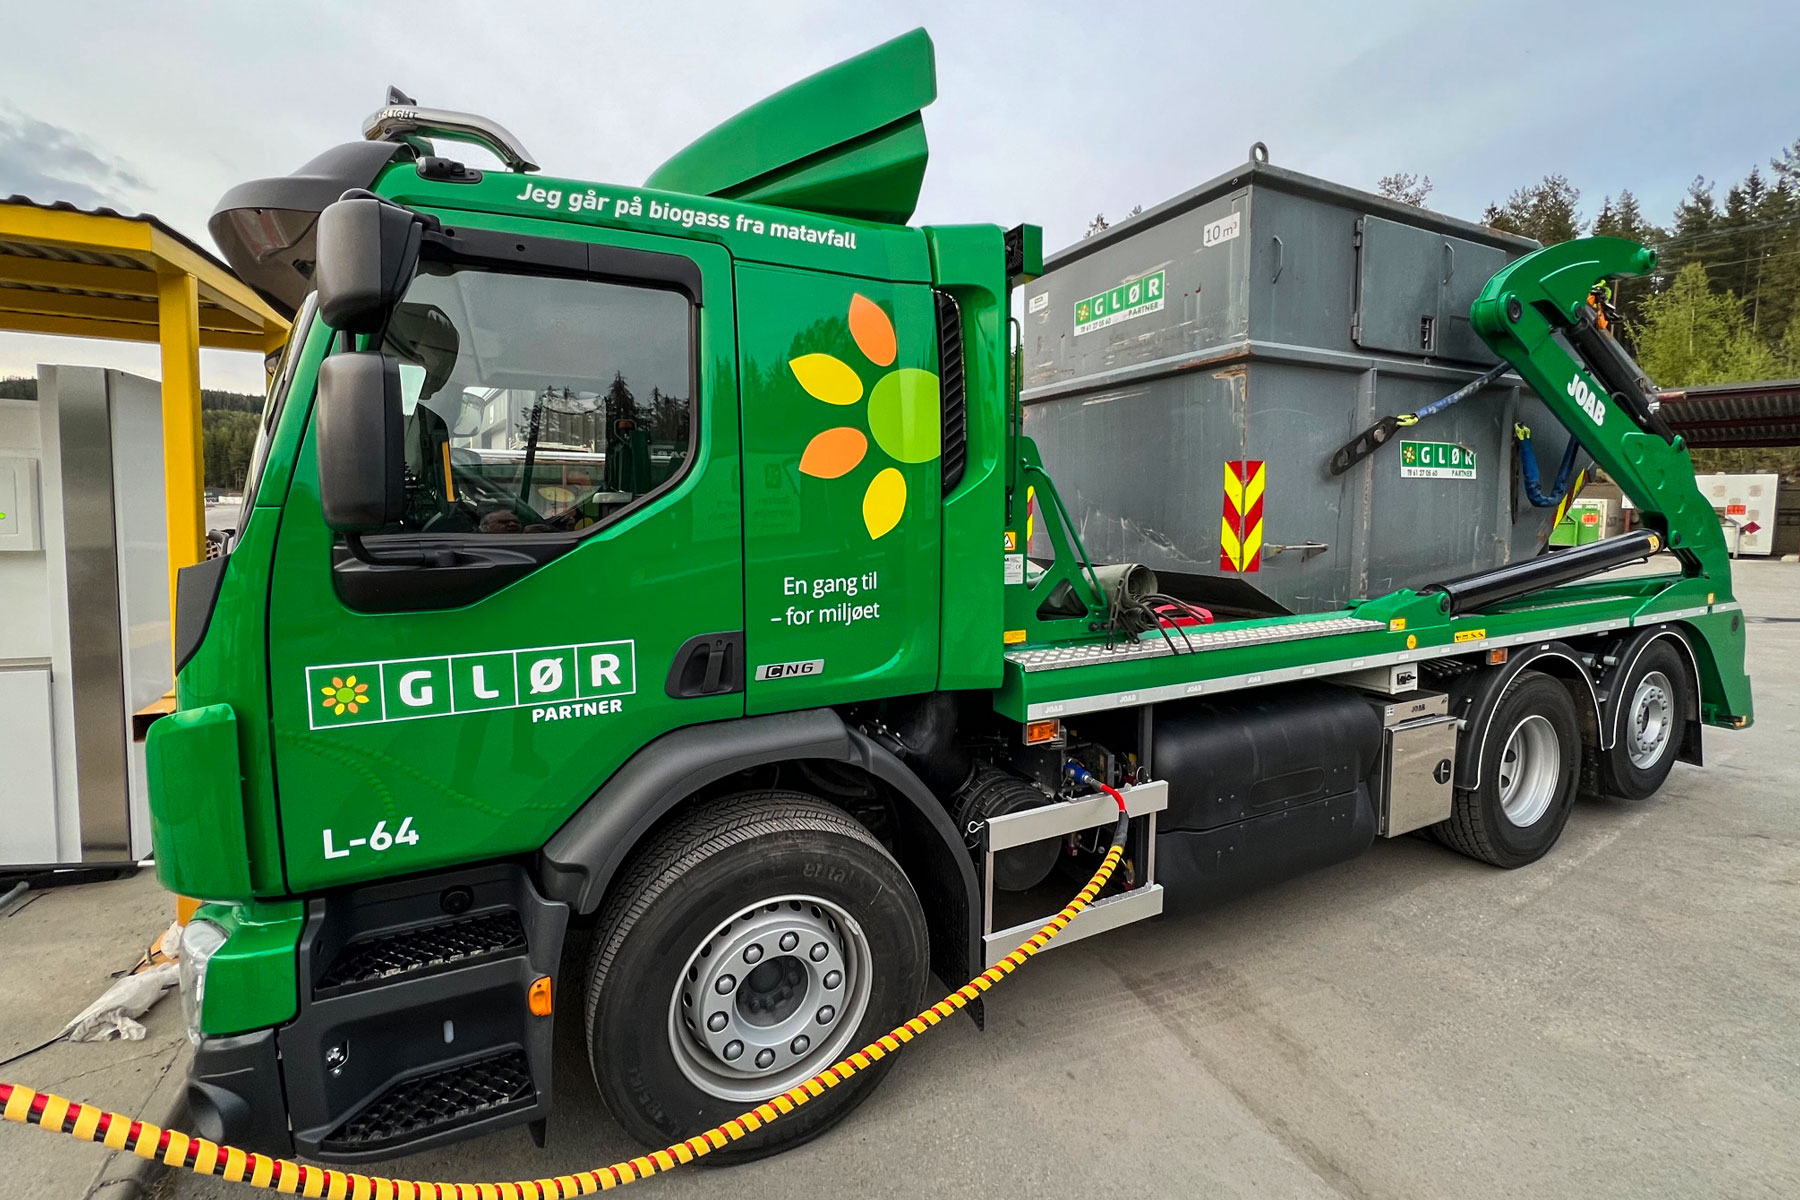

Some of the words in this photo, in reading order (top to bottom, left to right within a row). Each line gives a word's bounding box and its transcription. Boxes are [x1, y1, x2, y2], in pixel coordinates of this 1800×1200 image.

[516, 183, 562, 209] Jeg
[568, 189, 610, 212] går
[614, 196, 643, 218] på
[649, 201, 730, 228] biogass
[735, 214, 764, 235] fra
[769, 223, 857, 250] matavfall
[1206, 225, 1220, 244] 10
[1094, 277, 1160, 316] GLØR
[1128, 301, 1159, 319] PARTNER
[1566, 373, 1606, 427] JOAB
[1421, 446, 1473, 466] GLØR
[1451, 469, 1473, 477] PARTNER
[783, 576, 808, 596] En
[812, 576, 858, 599] gang
[861, 571, 878, 590] til
[786, 606, 815, 626] for
[819, 602, 880, 626] miljøet
[399, 652, 622, 707] GLØR
[765, 662, 814, 679] CNG
[1119, 695, 1137, 703] JOAB
[1186, 685, 1202, 693] JOAB
[531, 699, 623, 723] PARTNER
[1045, 704, 1064, 714] JOAB
[322, 816, 420, 860] L-64
